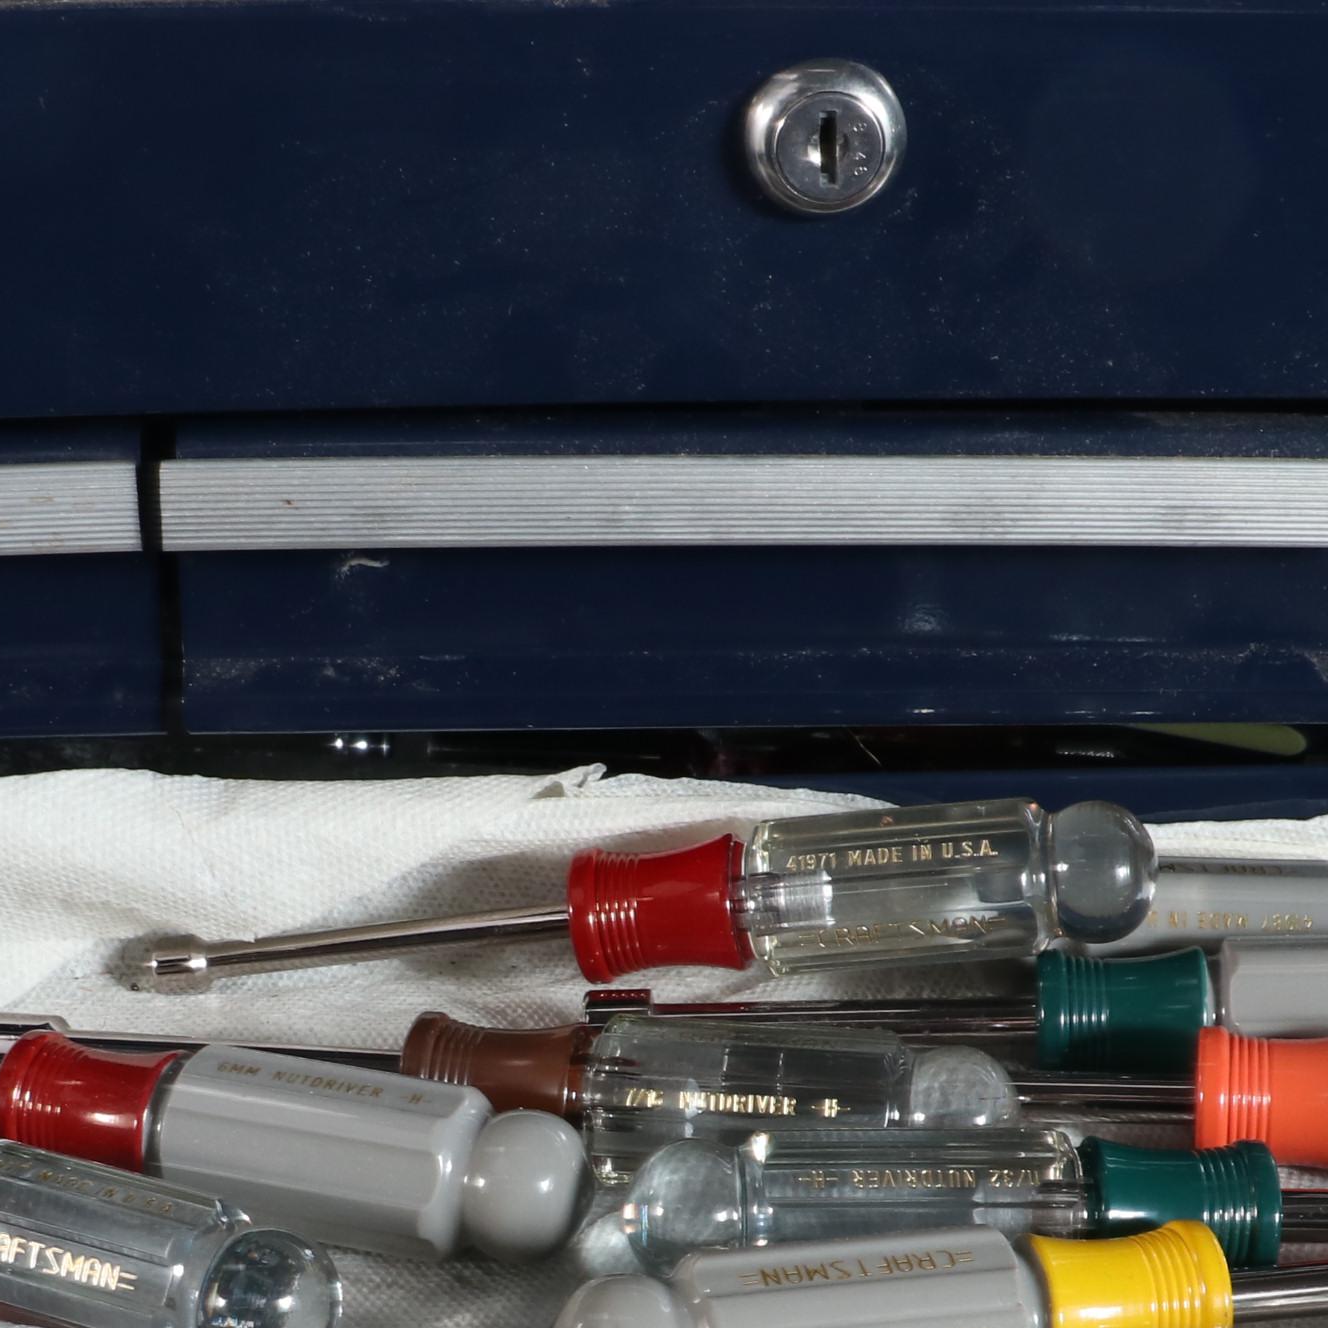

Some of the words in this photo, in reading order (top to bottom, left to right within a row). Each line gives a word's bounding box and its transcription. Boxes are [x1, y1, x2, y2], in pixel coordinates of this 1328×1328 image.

[847, 846, 903, 867] MADE
[911, 843, 933, 862] IN
[941, 838, 1000, 859] U.S.A.
[271, 1067, 385, 1100] NUTDRIVER
[850, 1168, 977, 1190] NUTDRIVER
[756, 1249, 961, 1288] CRAFTSMAN
